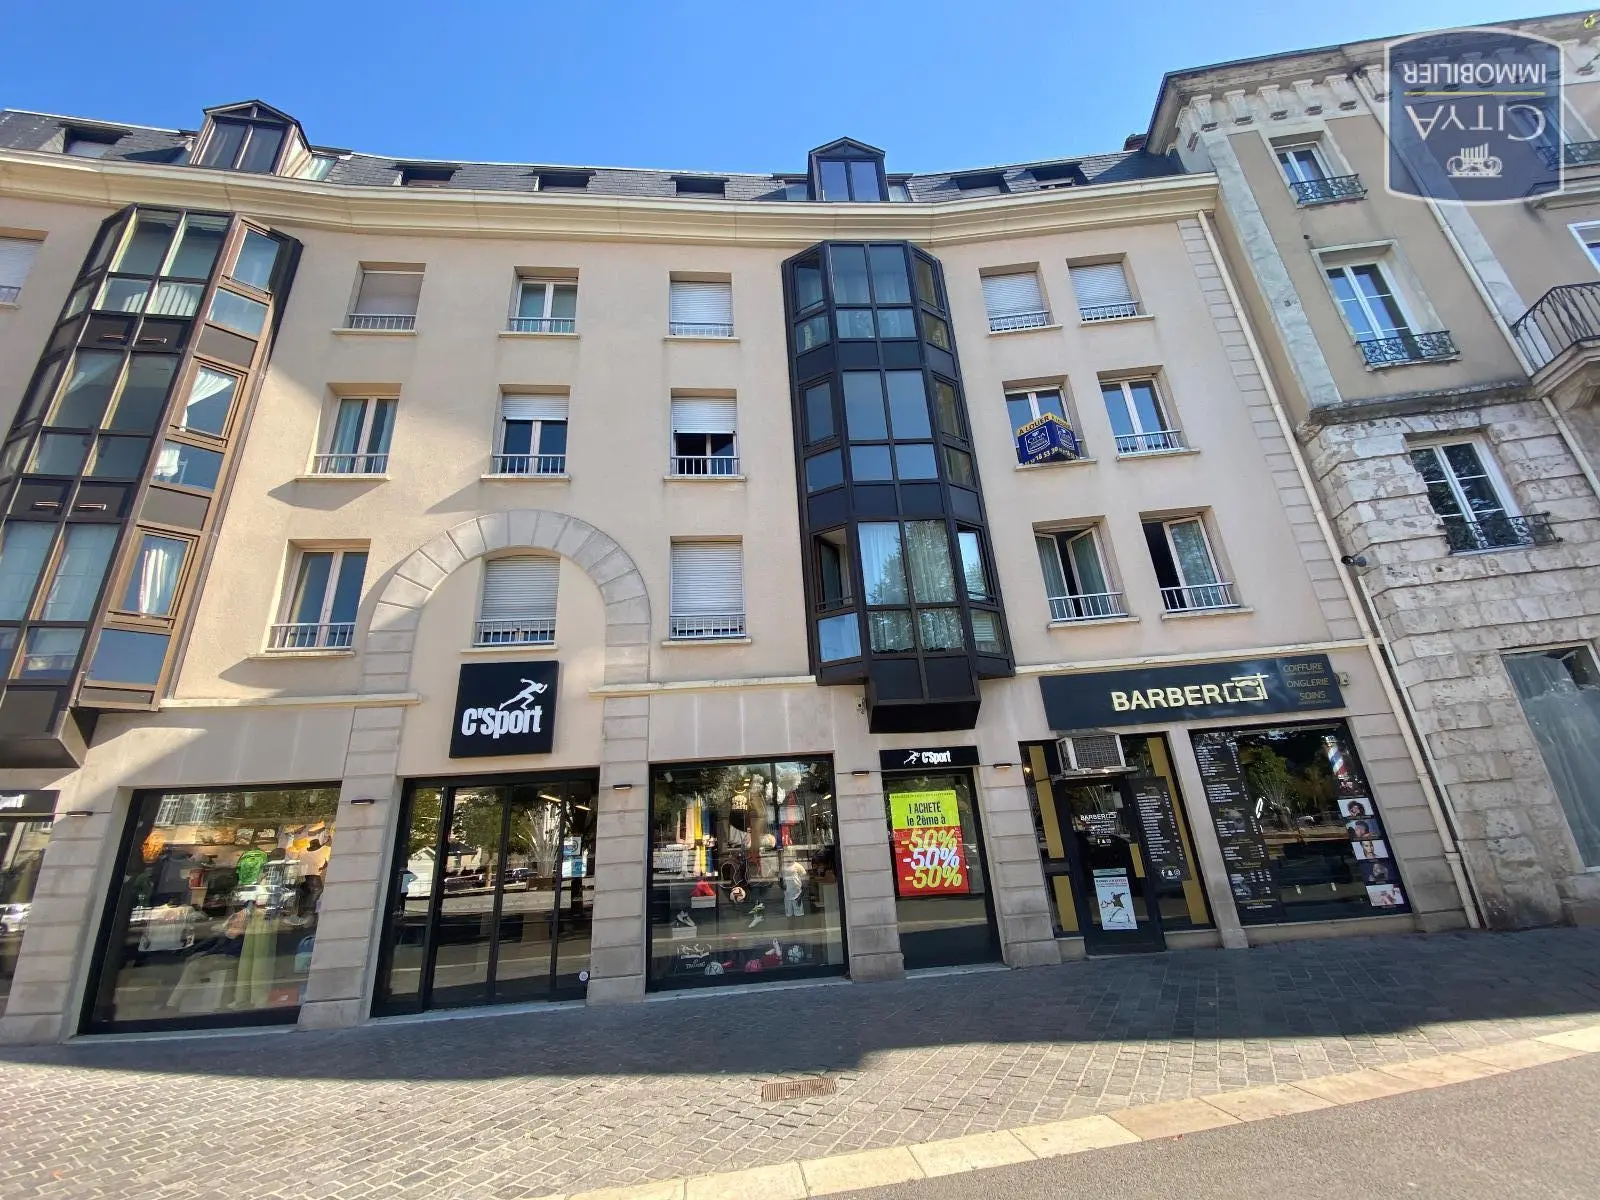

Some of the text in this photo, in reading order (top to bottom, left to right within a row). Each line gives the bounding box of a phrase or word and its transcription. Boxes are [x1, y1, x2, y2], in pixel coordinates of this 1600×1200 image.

[1025, 415, 1049, 430] LOUER
[1283, 662, 1324, 674] COIFFURE
[1286, 677, 1329, 688] ONGLERIE
[1299, 690, 1326, 701] SOINS
[461, 705, 542, 739] C'Sport
[906, 813, 946, 827] le 2ème à
[901, 829, 958, 852] -50%
[903, 848, 960, 870] -50%
[904, 866, 962, 889] -50%
